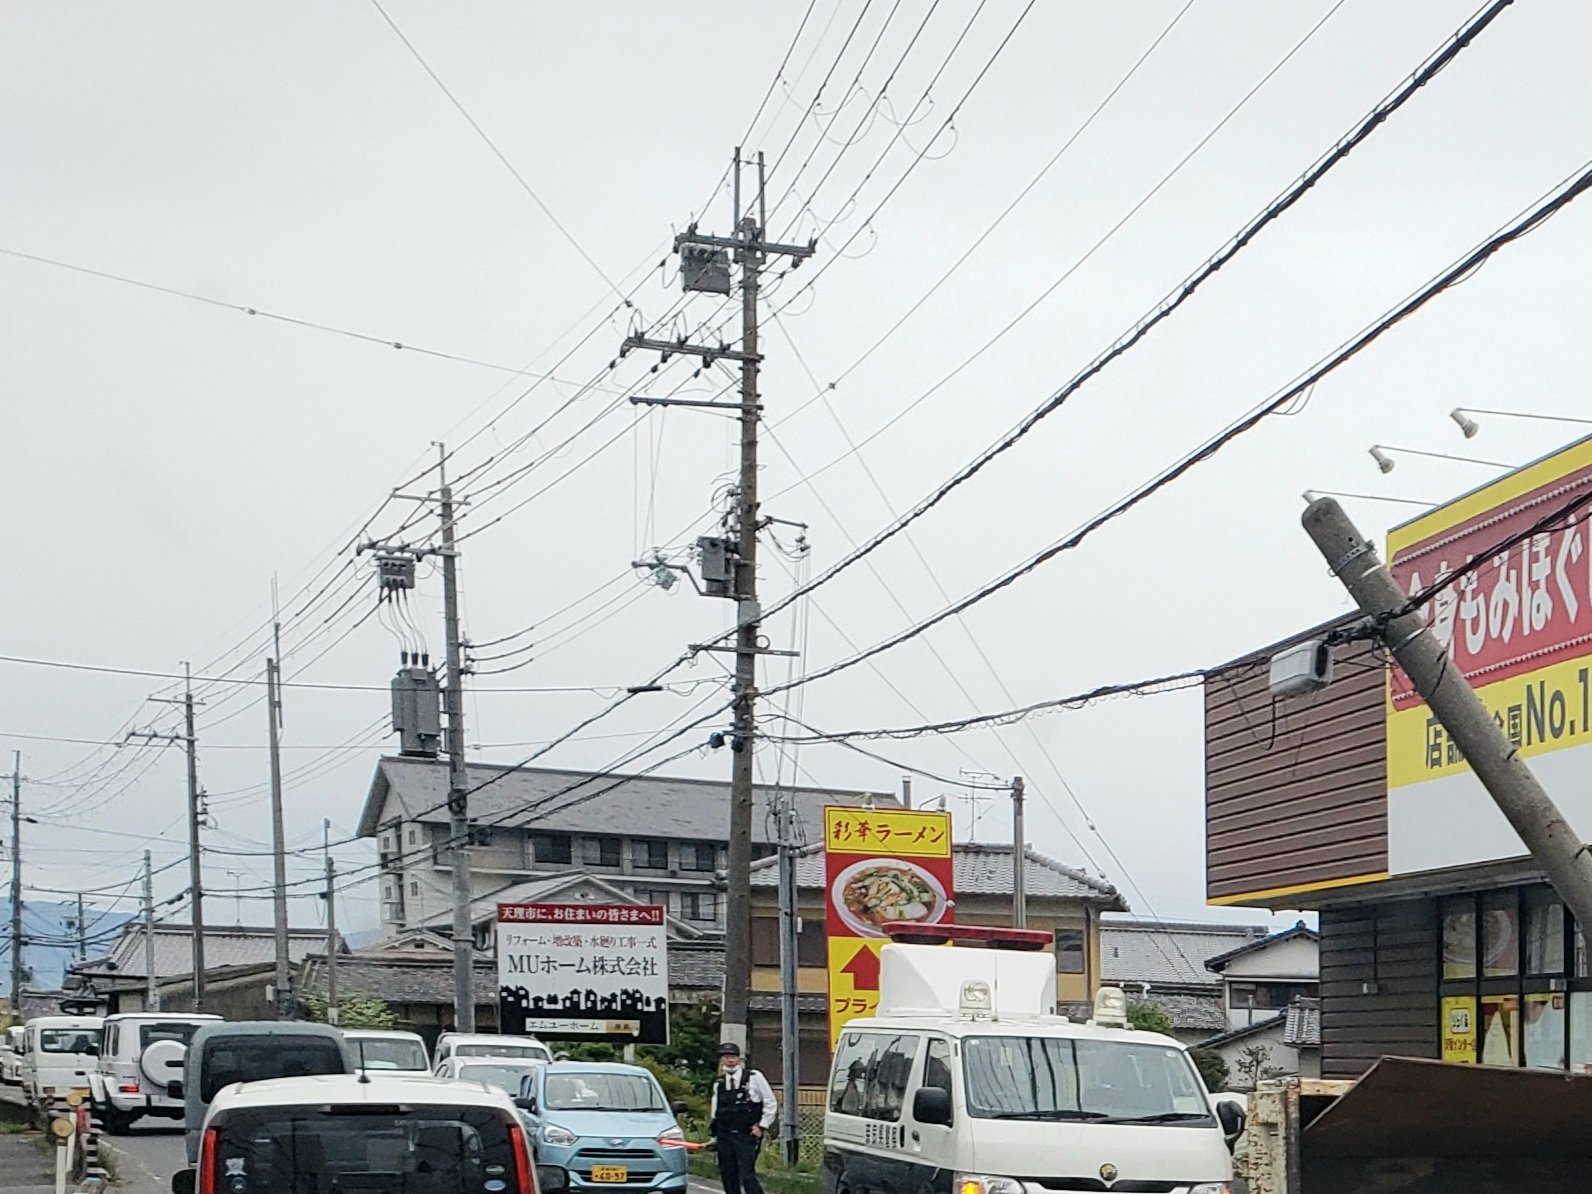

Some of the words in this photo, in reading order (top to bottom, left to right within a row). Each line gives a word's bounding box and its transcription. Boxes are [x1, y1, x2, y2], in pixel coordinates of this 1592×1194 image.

[833, 819, 945, 844] 彩華ラーメン
[507, 954, 658, 977] MUホーム株式会社
